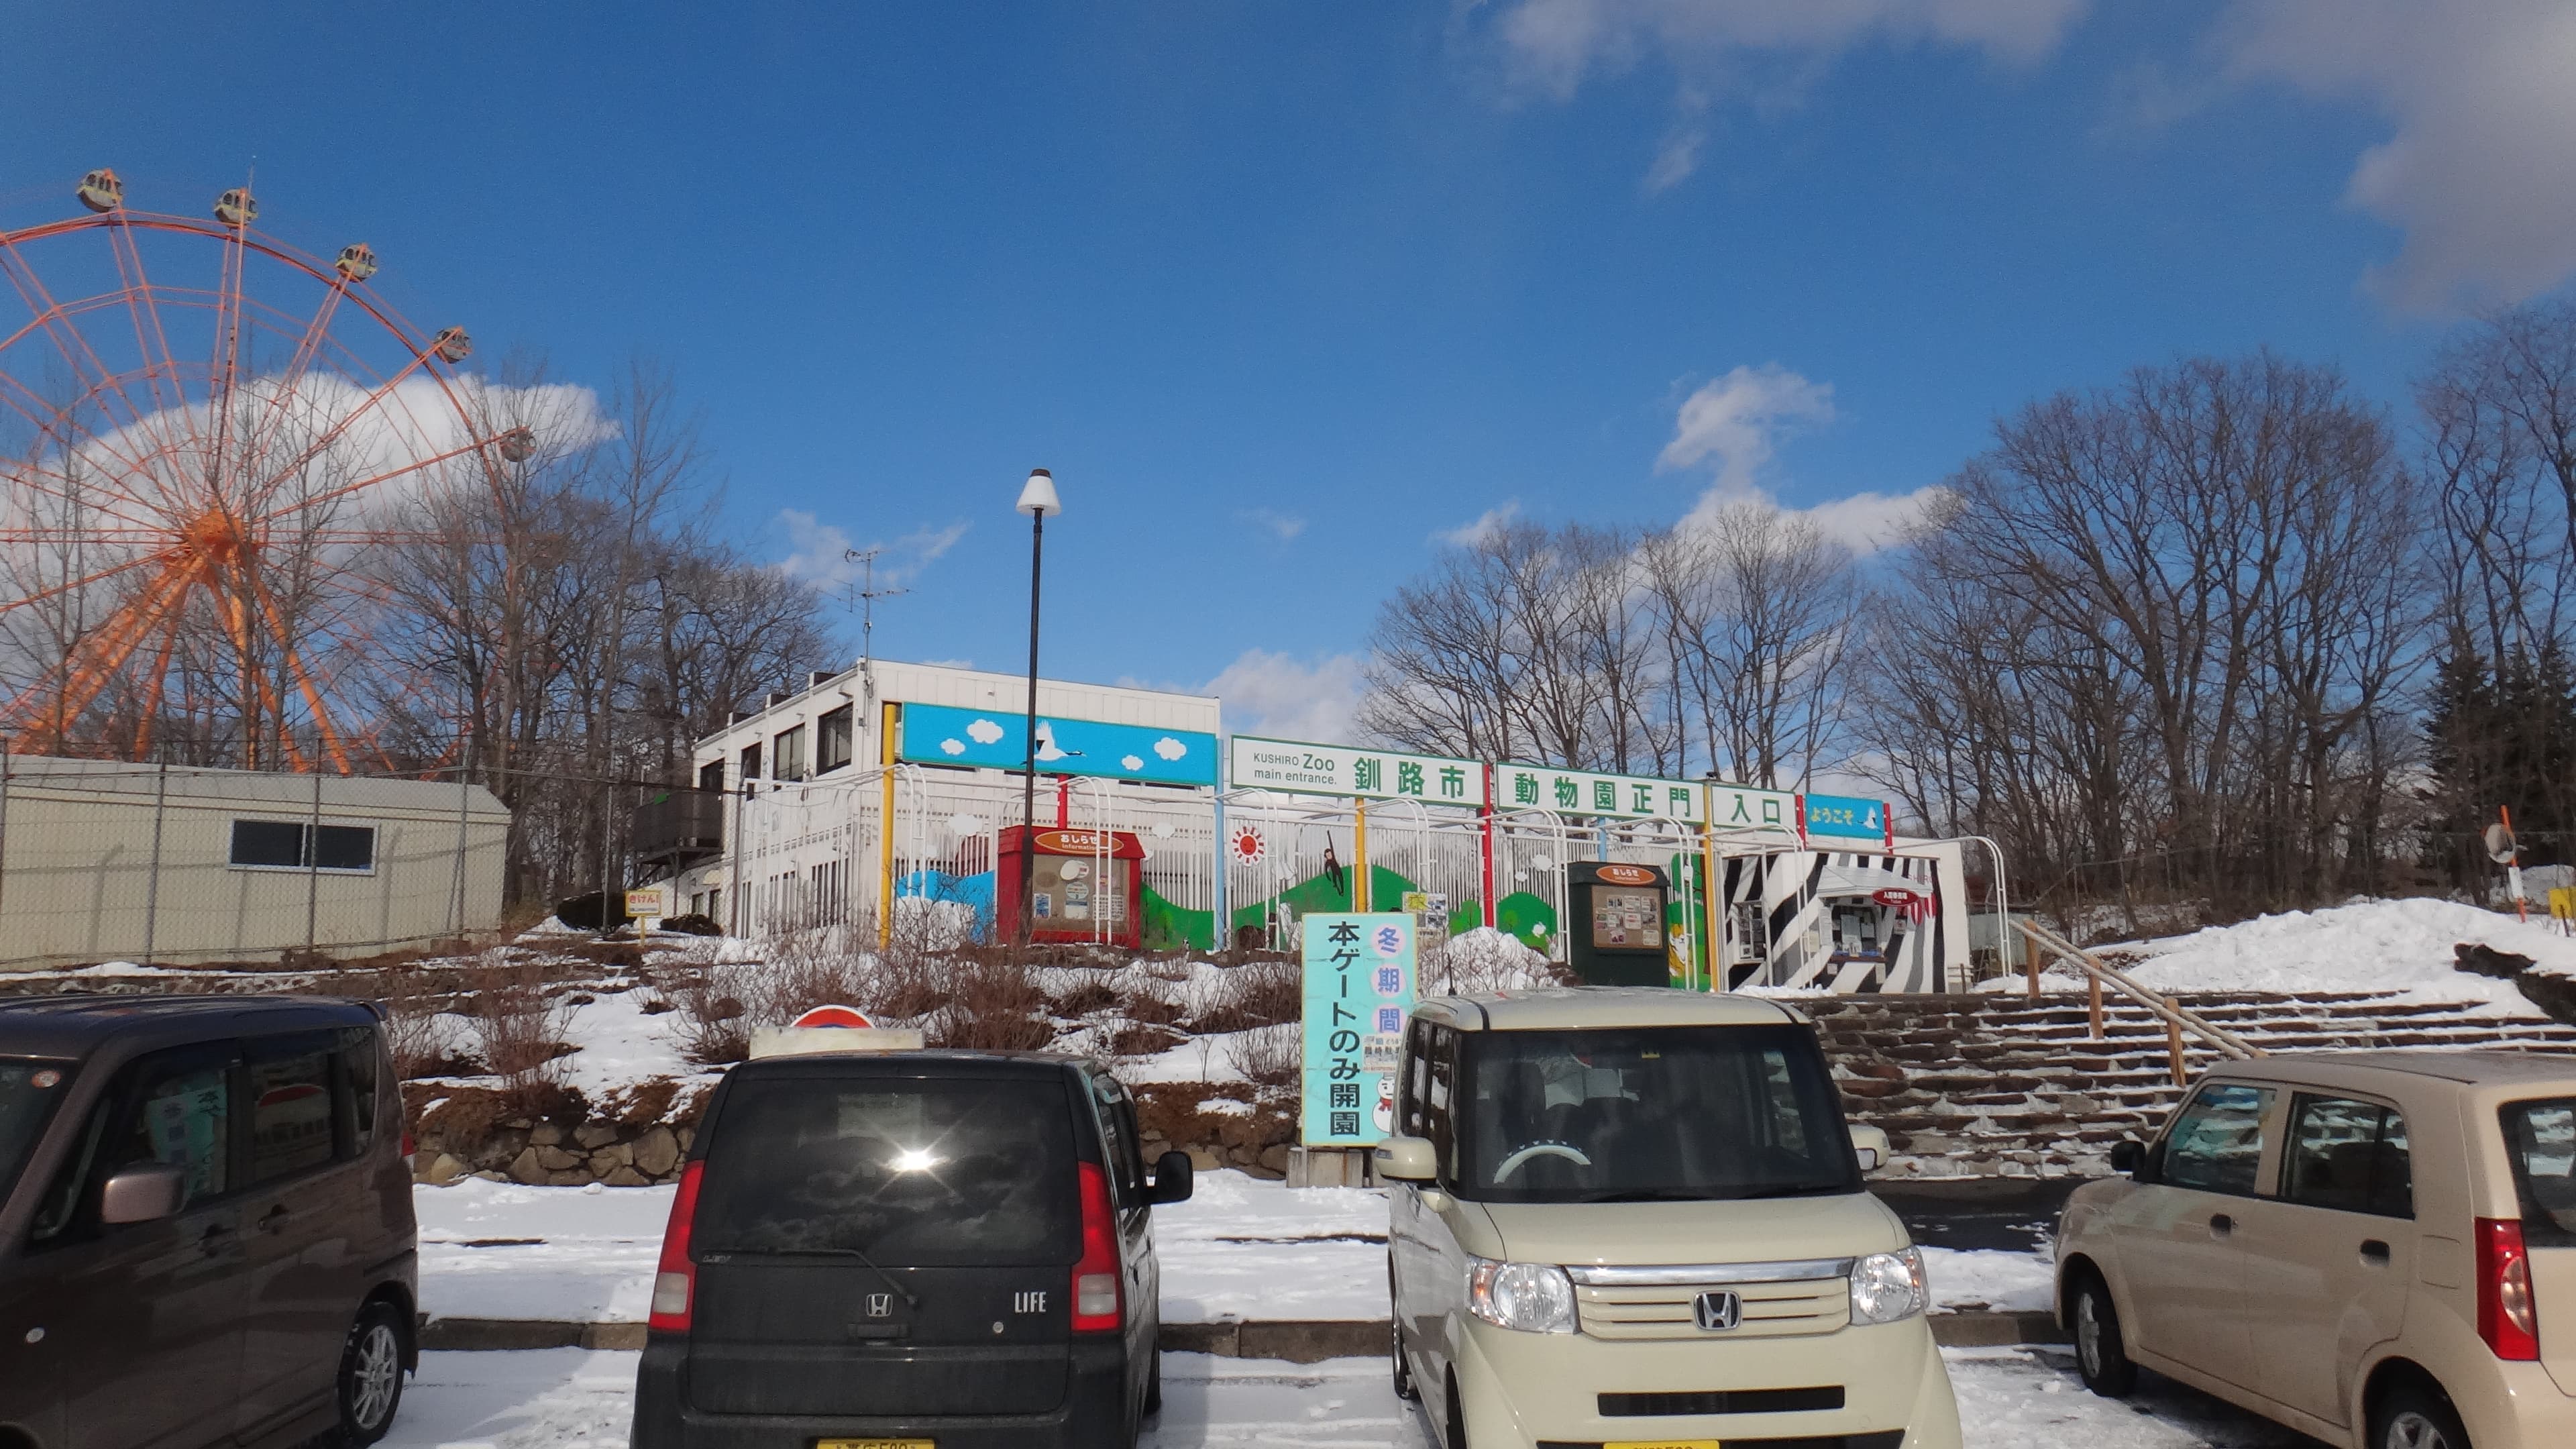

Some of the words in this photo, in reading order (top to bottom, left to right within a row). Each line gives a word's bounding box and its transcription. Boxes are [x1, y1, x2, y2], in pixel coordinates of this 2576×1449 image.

[1254, 753, 1299, 766] KUSHIRO
[1303, 753, 1335, 771] Zoo
[1254, 769, 1281, 780] main
[1285, 771, 1337, 785] entrance.
[1353, 756, 1466, 799] 釧路市
[1514, 772, 1691, 817] 動物園正門
[1731, 794, 1781, 824] 入口
[1811, 806, 1854, 826] ようこそ
[1060, 833, 1098, 845] おしらせ
[1377, 926, 1401, 1033] 冬期間
[1328, 920, 1361, 1136] 本ゲートのみ開園
[1014, 1291, 1047, 1313] LIFE
